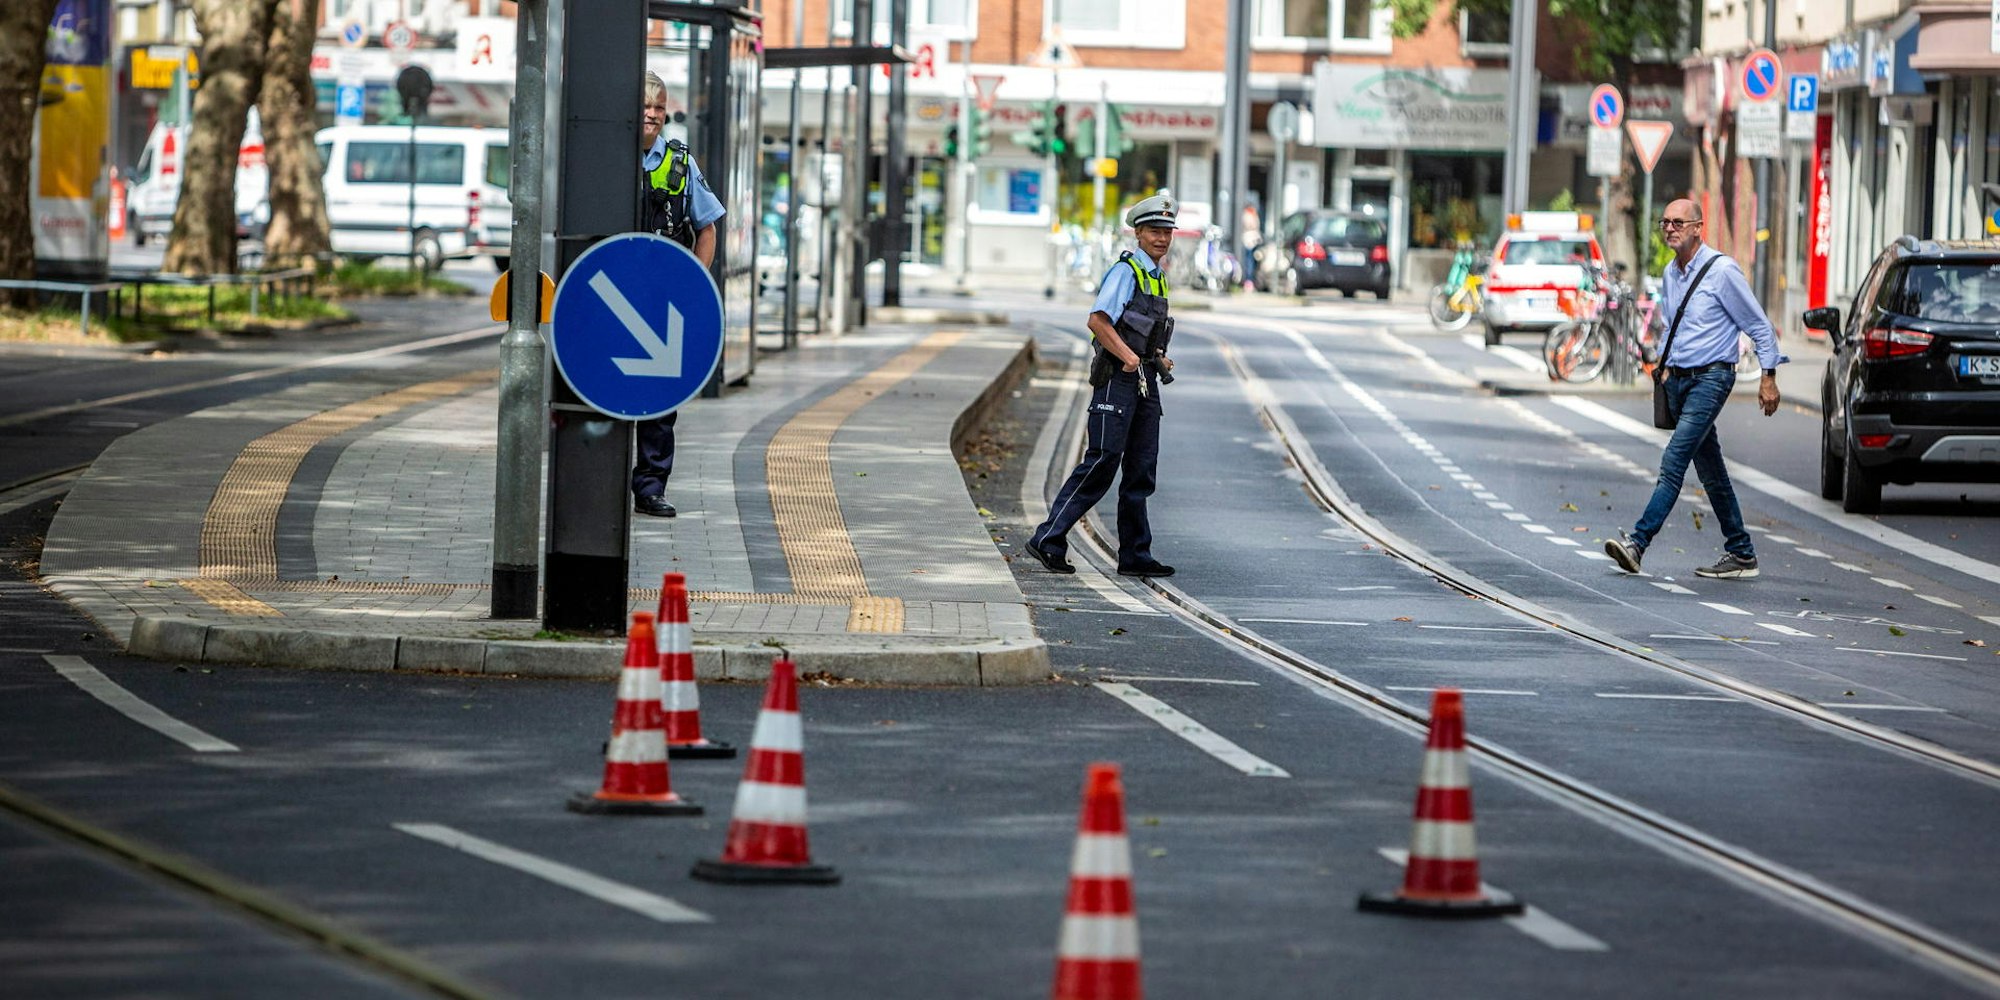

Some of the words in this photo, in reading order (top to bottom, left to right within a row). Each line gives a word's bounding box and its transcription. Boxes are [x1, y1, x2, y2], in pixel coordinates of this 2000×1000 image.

[471, 34, 493, 65] A
[912, 43, 935, 78] A
[1794, 78, 1812, 110] P
[1970, 357, 1980, 373] K
[1097, 403, 1115, 412] POLIZEI
